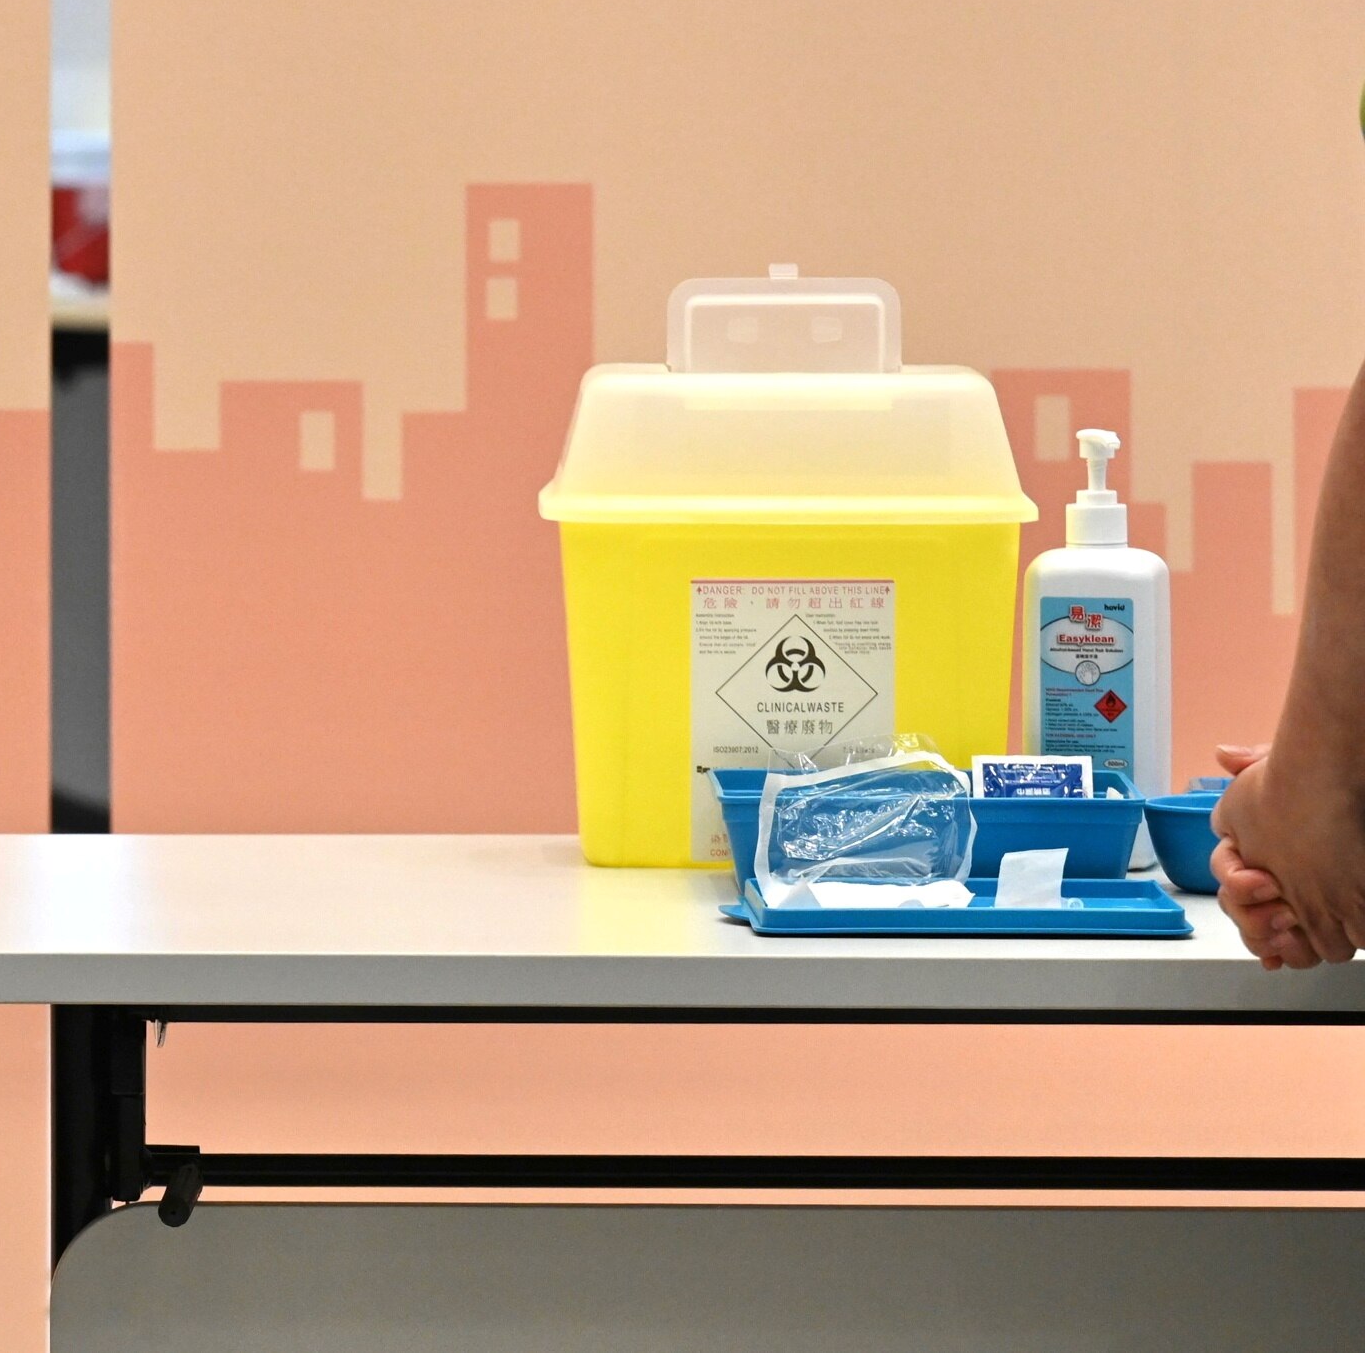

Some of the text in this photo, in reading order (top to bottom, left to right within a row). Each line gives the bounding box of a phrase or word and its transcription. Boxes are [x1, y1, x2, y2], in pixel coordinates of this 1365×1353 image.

[752, 586, 765, 595] DO
[768, 586, 785, 595] NOT
[789, 586, 806, 595] FILL
[810, 586, 838, 595] ABOVE
[842, 586, 862, 595] THIS
[865, 586, 885, 595] LINE
[1059, 635, 1114, 646] Easyklean
[766, 719, 833, 735] 醫療廢物
